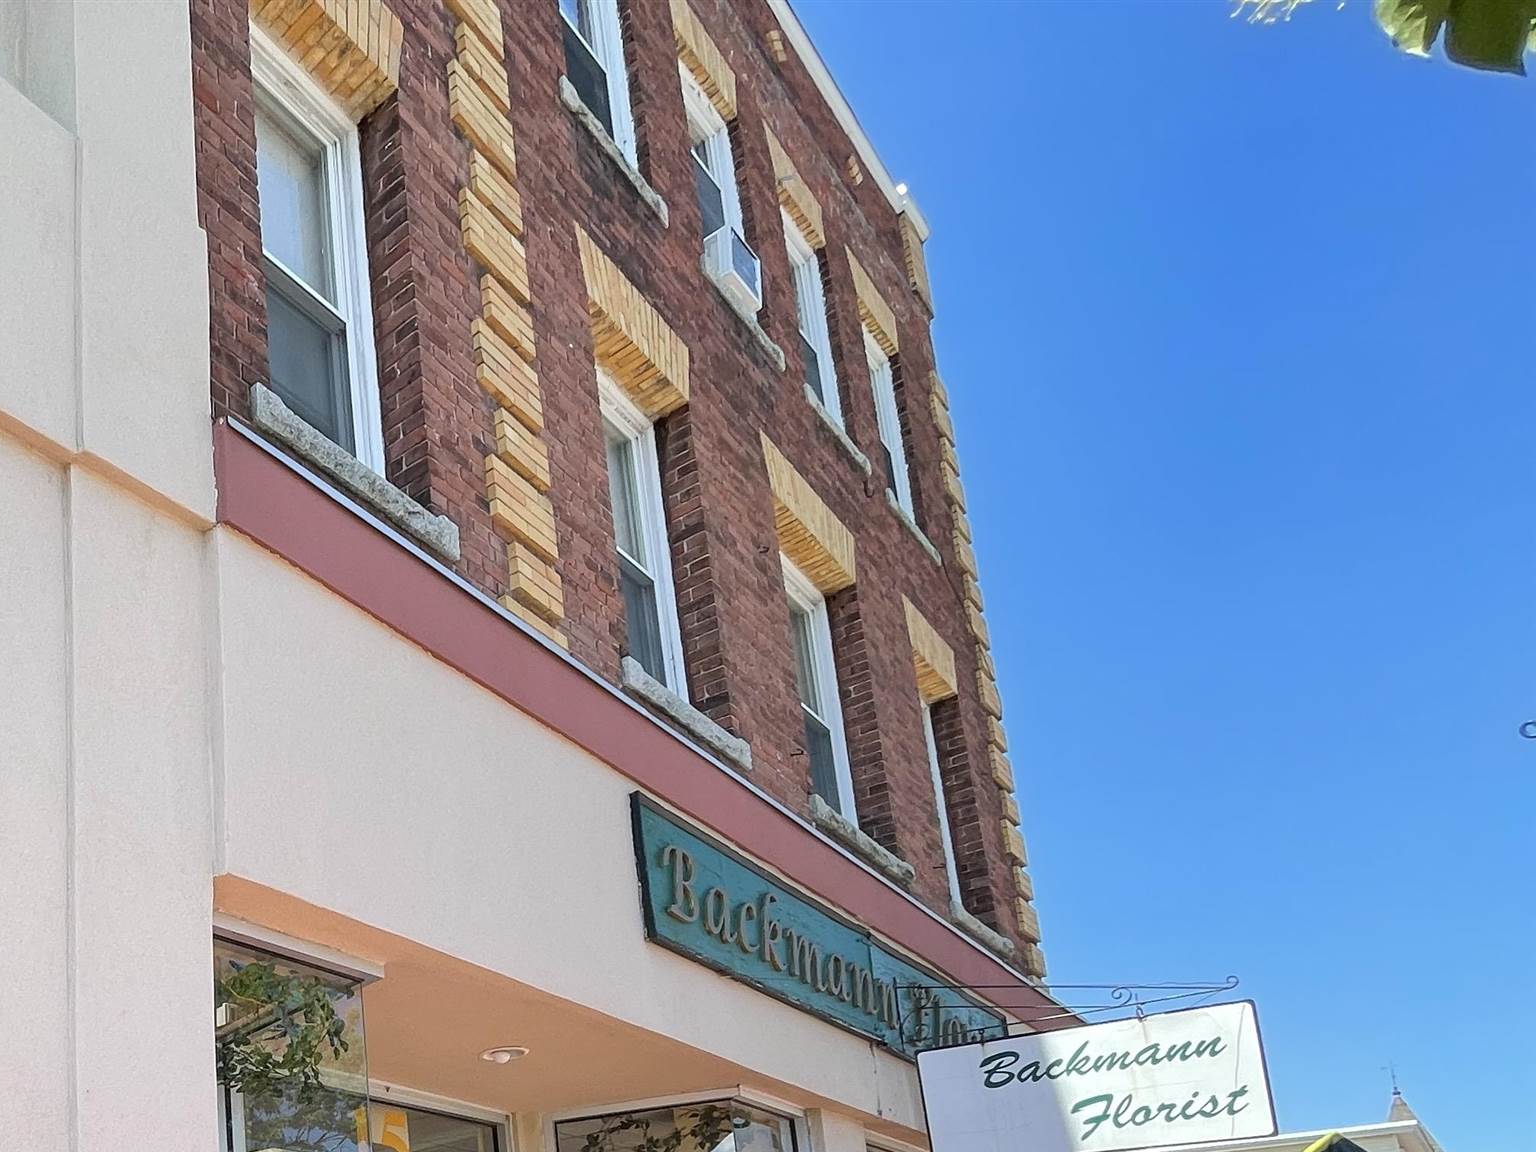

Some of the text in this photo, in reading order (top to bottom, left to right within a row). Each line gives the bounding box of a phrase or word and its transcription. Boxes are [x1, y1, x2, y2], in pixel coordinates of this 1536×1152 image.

[660, 843, 898, 1031] Backmann
[979, 1034, 1227, 1089] Backmann
[1070, 1085, 1250, 1141] Florist
